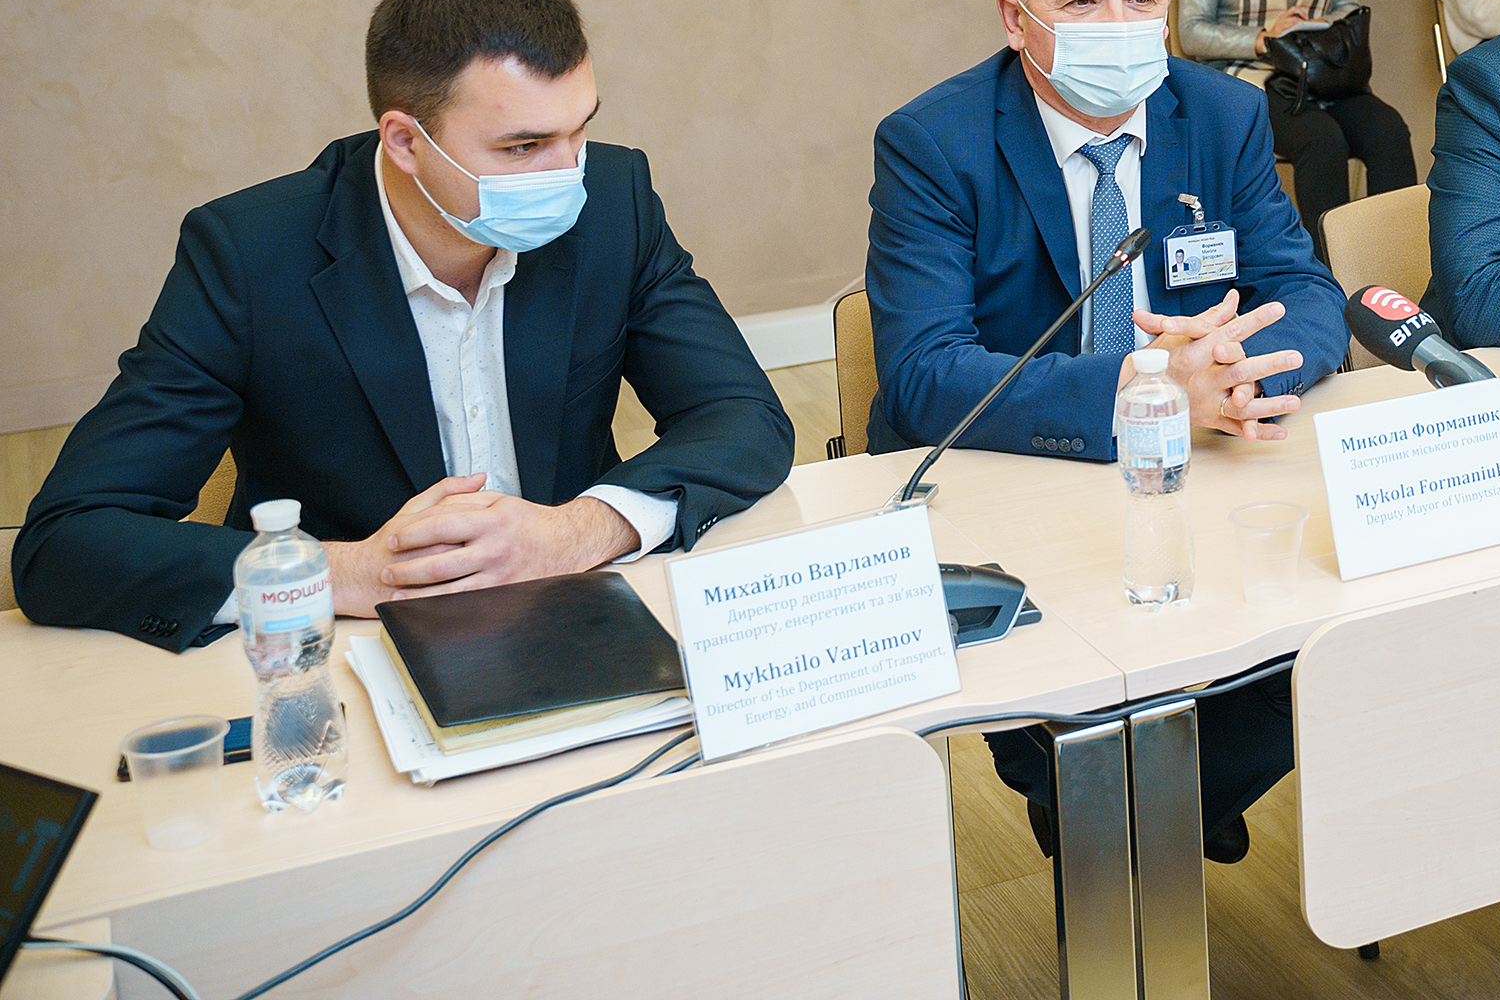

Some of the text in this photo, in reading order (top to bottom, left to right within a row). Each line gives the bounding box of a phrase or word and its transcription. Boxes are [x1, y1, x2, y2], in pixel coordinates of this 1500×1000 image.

[1341, 409, 1500, 453] Микола Форманюк
[1350, 431, 1498, 470] Заступник міського голови
[1355, 484, 1415, 510] Mykola
[1366, 509, 1404, 525] Deputy
[1406, 499, 1440, 516] Mayor
[1442, 496, 1453, 508] of
[703, 546, 911, 606] Михайло Варламов
[728, 572, 898, 624] Директор департаменту
[693, 621, 782, 651] транспорту,
[785, 599, 866, 629] енергетики
[869, 595, 884, 608] та
[706, 646, 946, 717] Director of the Department of Transport,
[724, 629, 922, 692] Mykhailo Varlamov
[745, 671, 917, 725] Energy, and Communications
